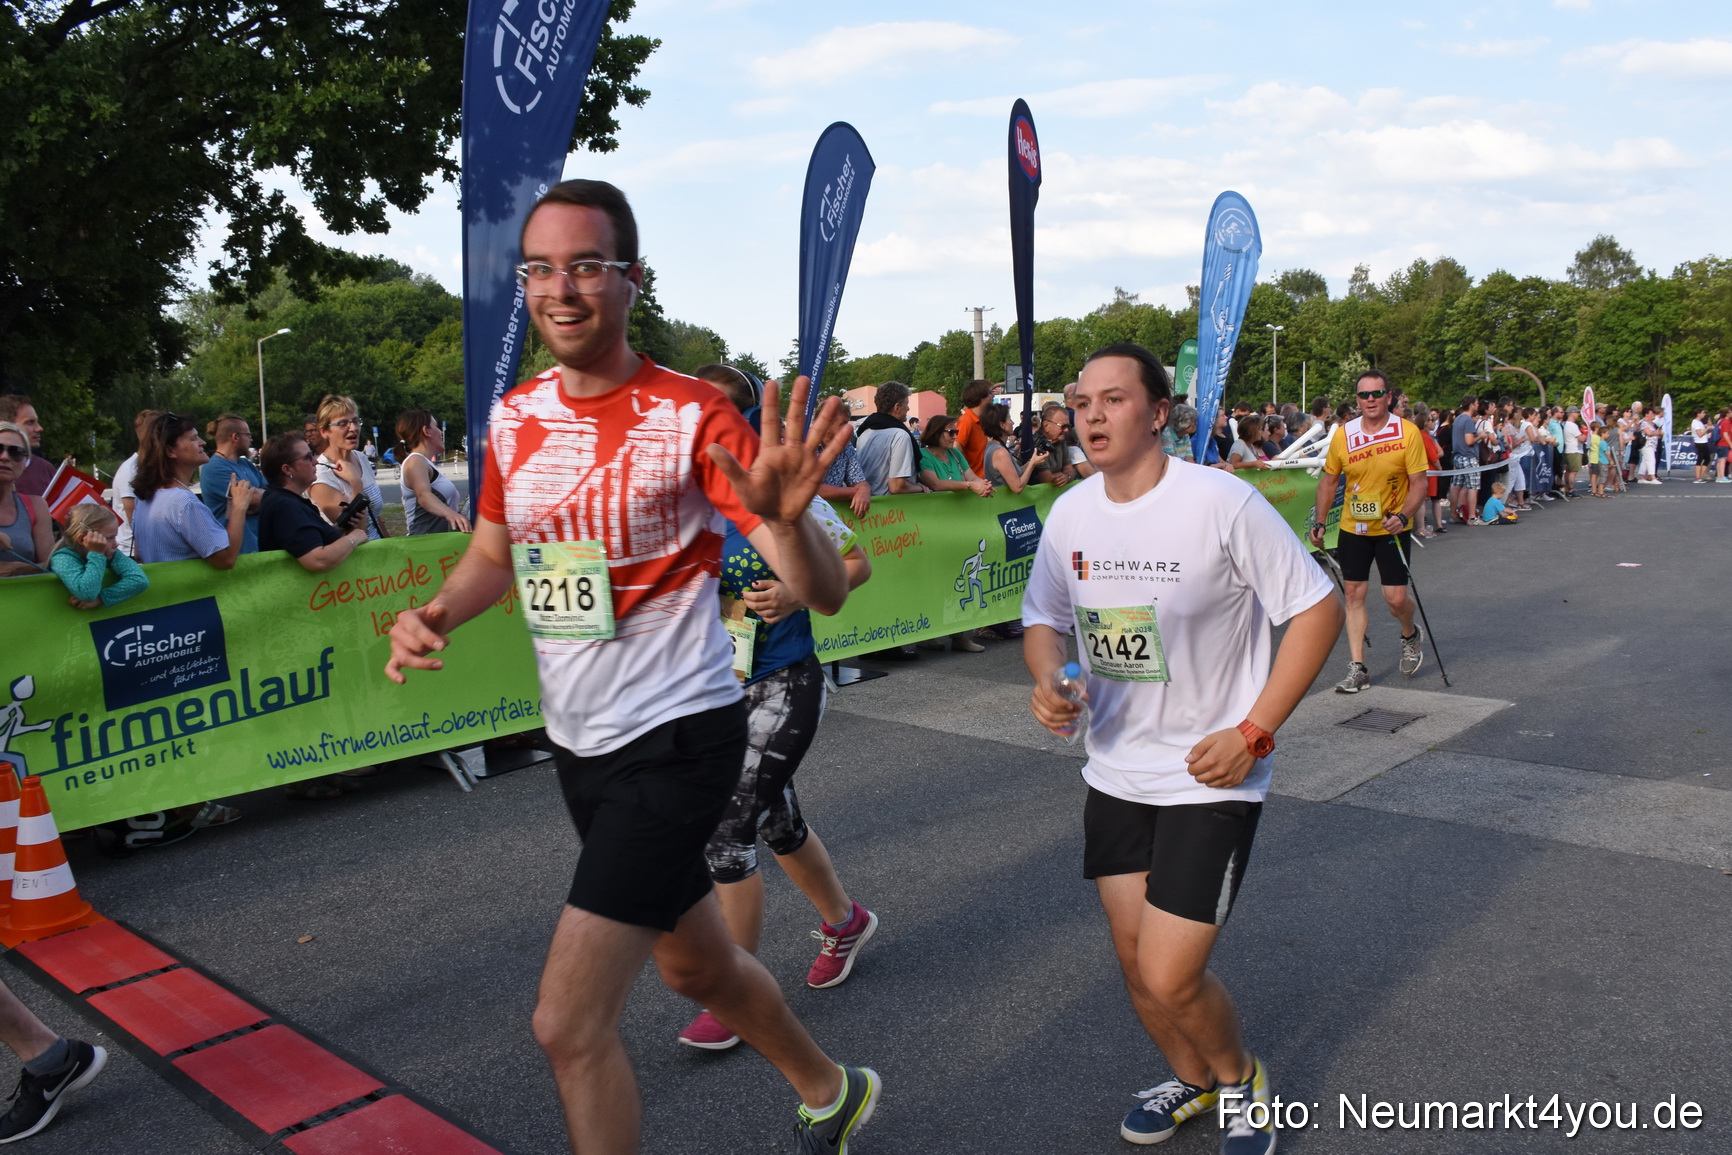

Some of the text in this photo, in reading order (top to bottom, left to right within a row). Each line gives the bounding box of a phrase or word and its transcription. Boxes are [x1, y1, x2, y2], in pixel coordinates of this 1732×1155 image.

[514, 0, 559, 85] Fisc
[826, 153, 852, 229] Fischer
[836, 168, 856, 228] AUTOMOBILE
[1348, 442, 1406, 465] MAX BÖGL
[1351, 502, 1377, 513] 1588
[871, 523, 923, 558] länger!
[1010, 521, 1036, 535] Fischer
[1092, 561, 1181, 572] SCHWARZ
[1139, 575, 1181, 583] SYSTEME
[309, 557, 432, 611] Gesunde
[526, 576, 595, 611] 2218
[125, 630, 206, 660] Fischer
[134, 645, 201, 668] AUTOMOBILE
[1088, 632, 1150, 660] 2142
[51, 646, 335, 769] firmenlauf
[64, 738, 197, 791] neumarkt
